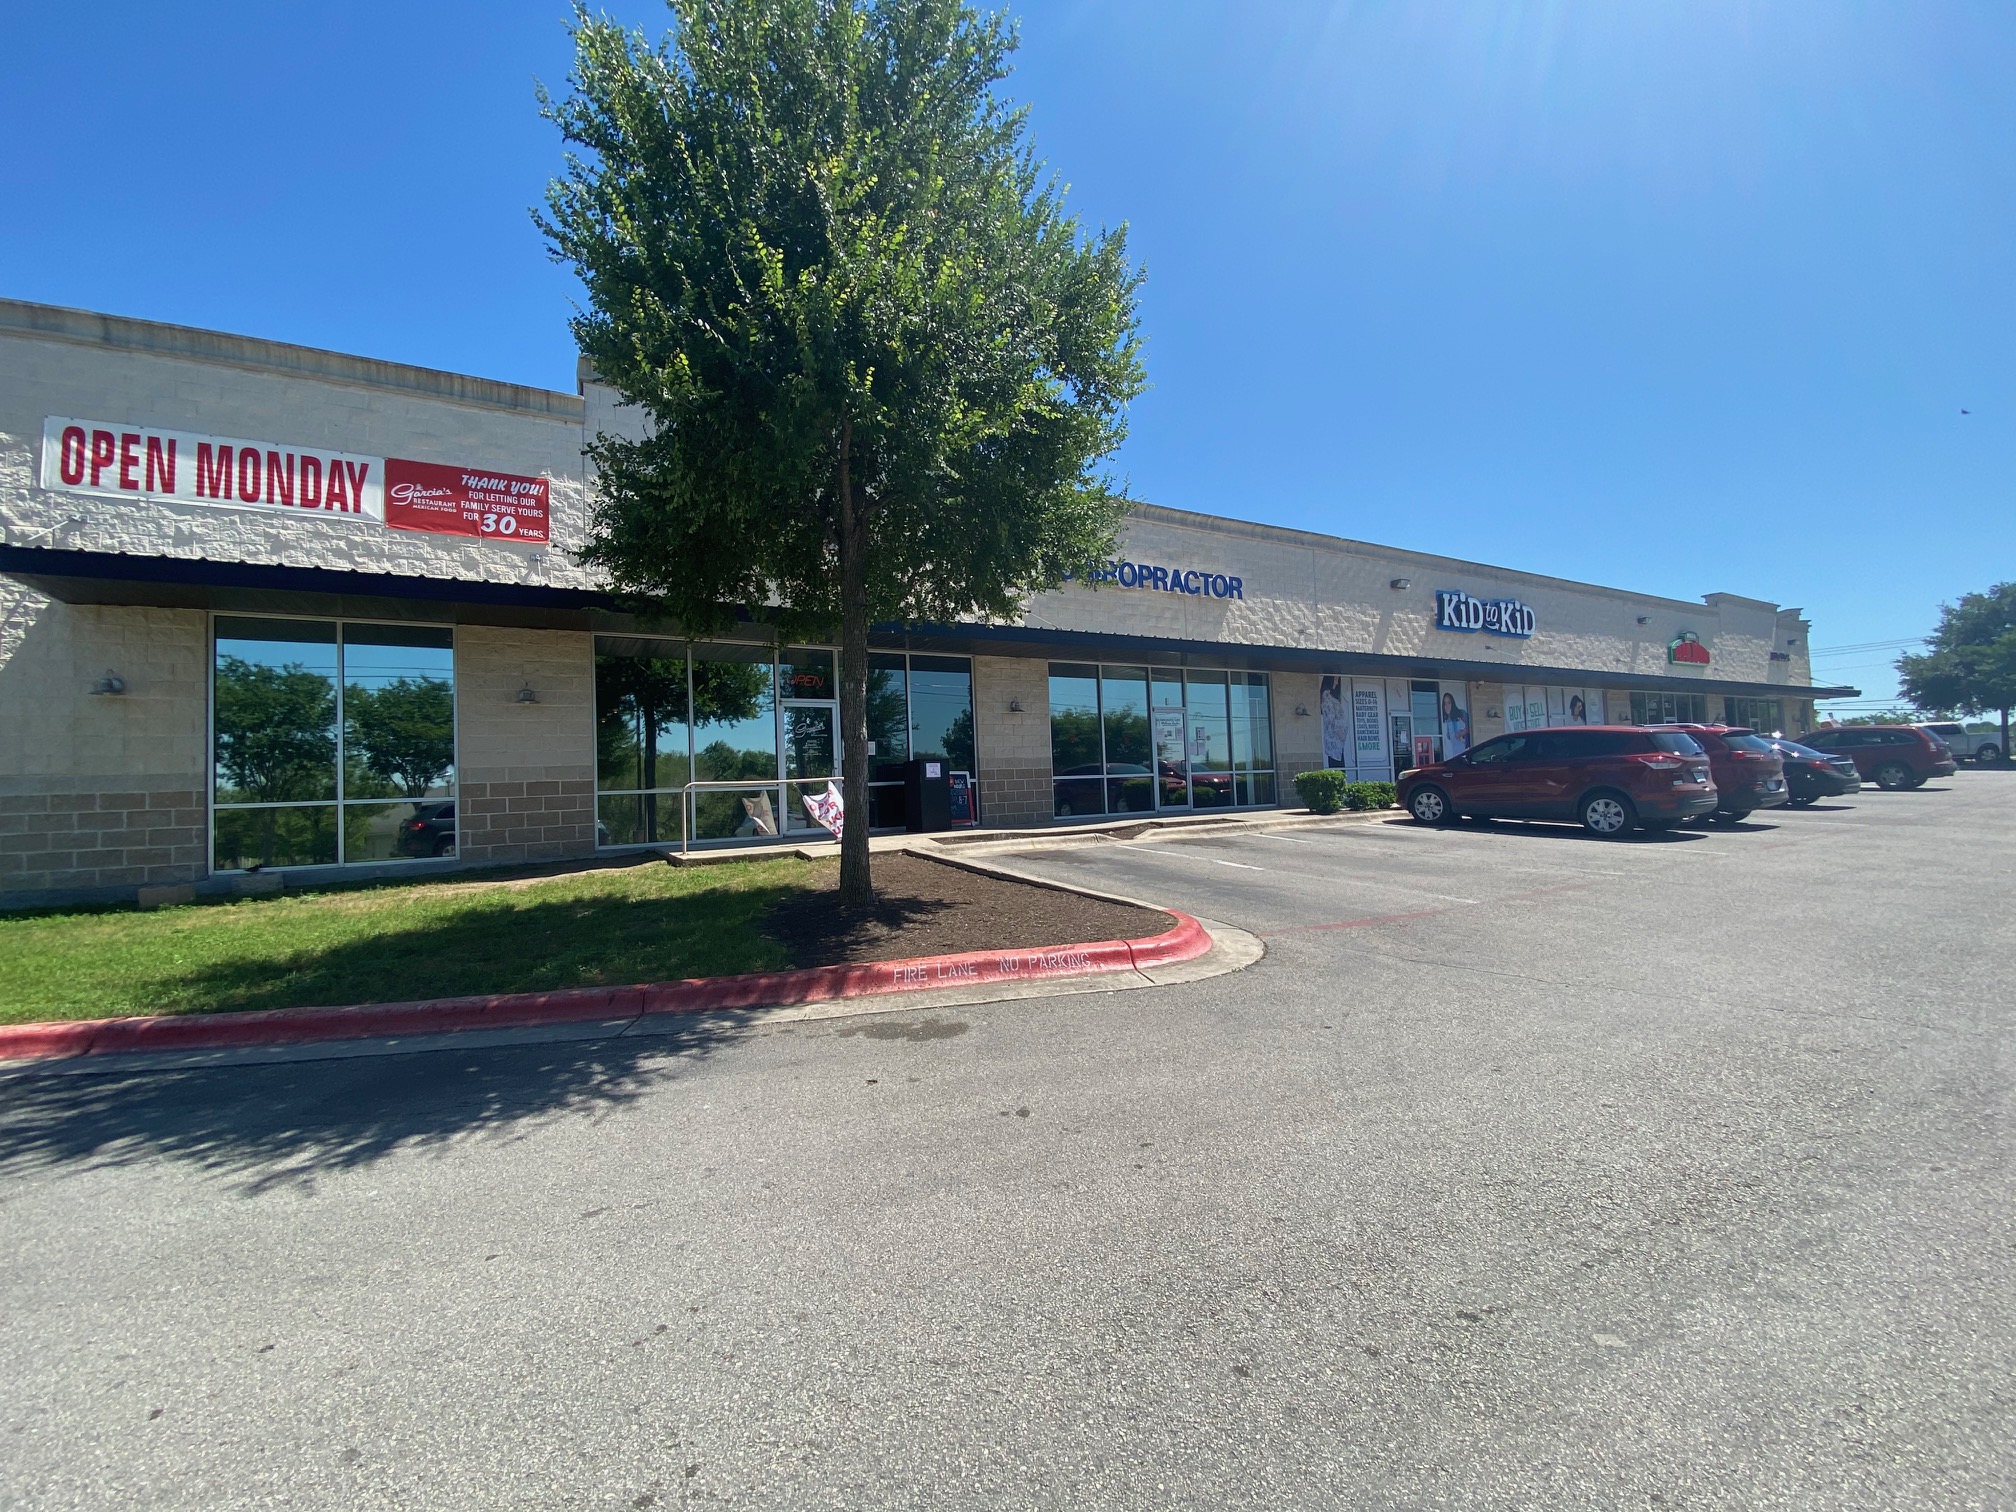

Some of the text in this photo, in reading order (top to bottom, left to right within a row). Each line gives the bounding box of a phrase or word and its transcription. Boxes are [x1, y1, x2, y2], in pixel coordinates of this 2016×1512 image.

[60, 425, 369, 514] OPEN MONDAY
[390, 483, 453, 505] Garcia's
[461, 474, 544, 496] THANK YOU!
[413, 498, 457, 508] RESTAURANT
[461, 500, 544, 518] FAMILY SERVE YOURS
[468, 491, 536, 507] FOR LETTING OUR
[463, 511, 544, 538] FOR 30 YEARS
[1485, 602, 1498, 622] to
[786, 674, 825, 687] OPEN
[1509, 702, 1545, 720] BUY SELL
[893, 952, 1091, 984] FIRE LANE NO PARKING
